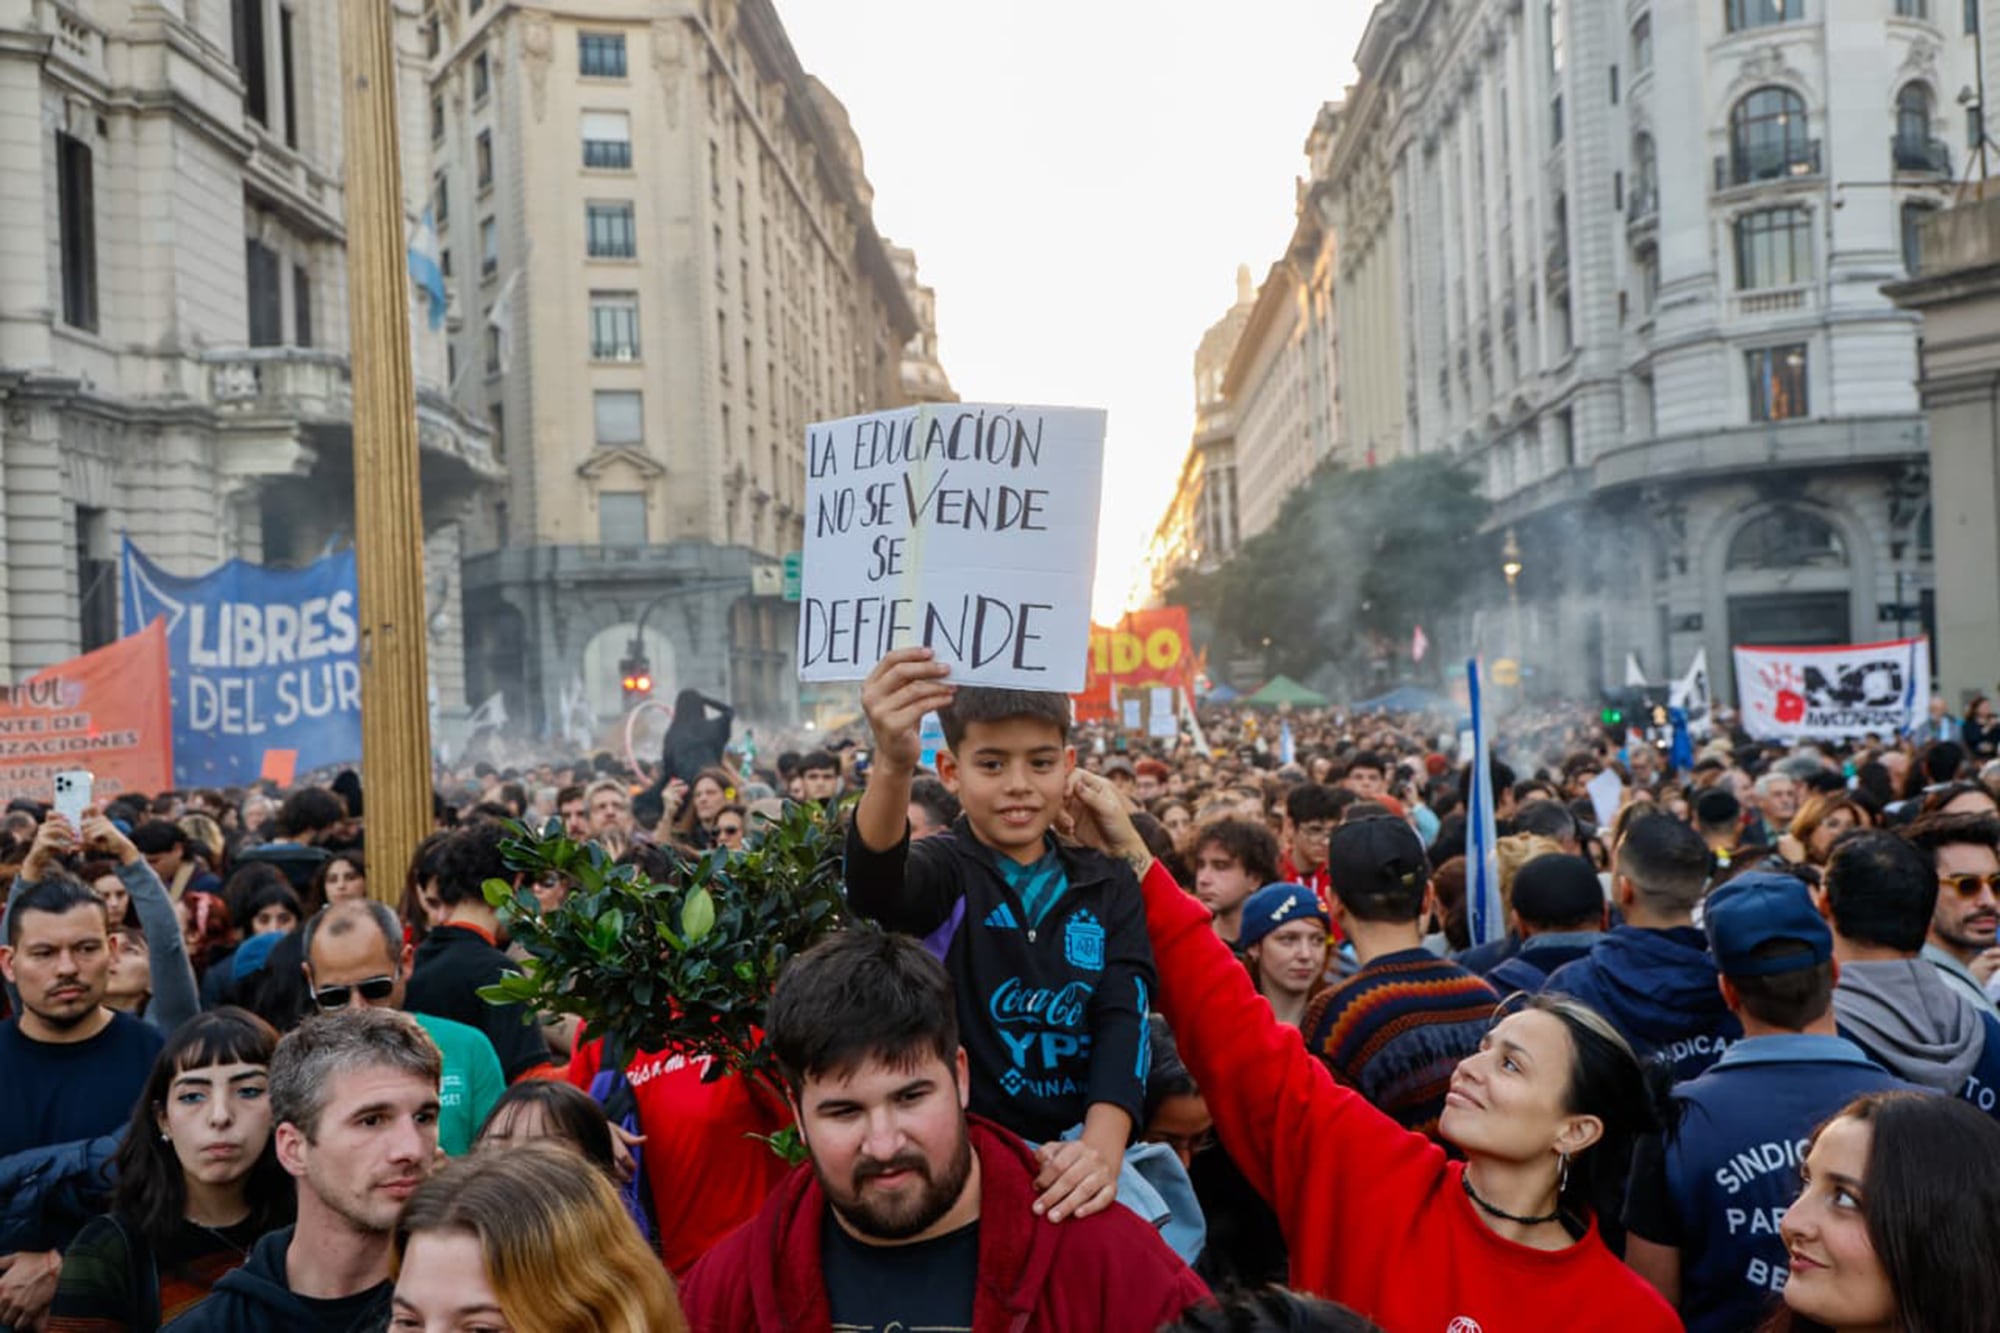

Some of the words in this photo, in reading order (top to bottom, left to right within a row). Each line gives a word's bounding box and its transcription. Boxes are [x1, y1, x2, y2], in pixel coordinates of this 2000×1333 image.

[810, 431, 837, 478] LA
[853, 407, 1043, 470] EDUCACIÓN
[817, 488, 855, 538] NO
[860, 482, 896, 527] SE
[903, 468, 1049, 532] VENDE
[867, 534, 907, 582] SE
[188, 589, 357, 667] LIBRES
[189, 675, 266, 735] DEL
[274, 660, 361, 726] SUR
[1803, 661, 1903, 707] NO
[53, 715, 88, 729] DE
